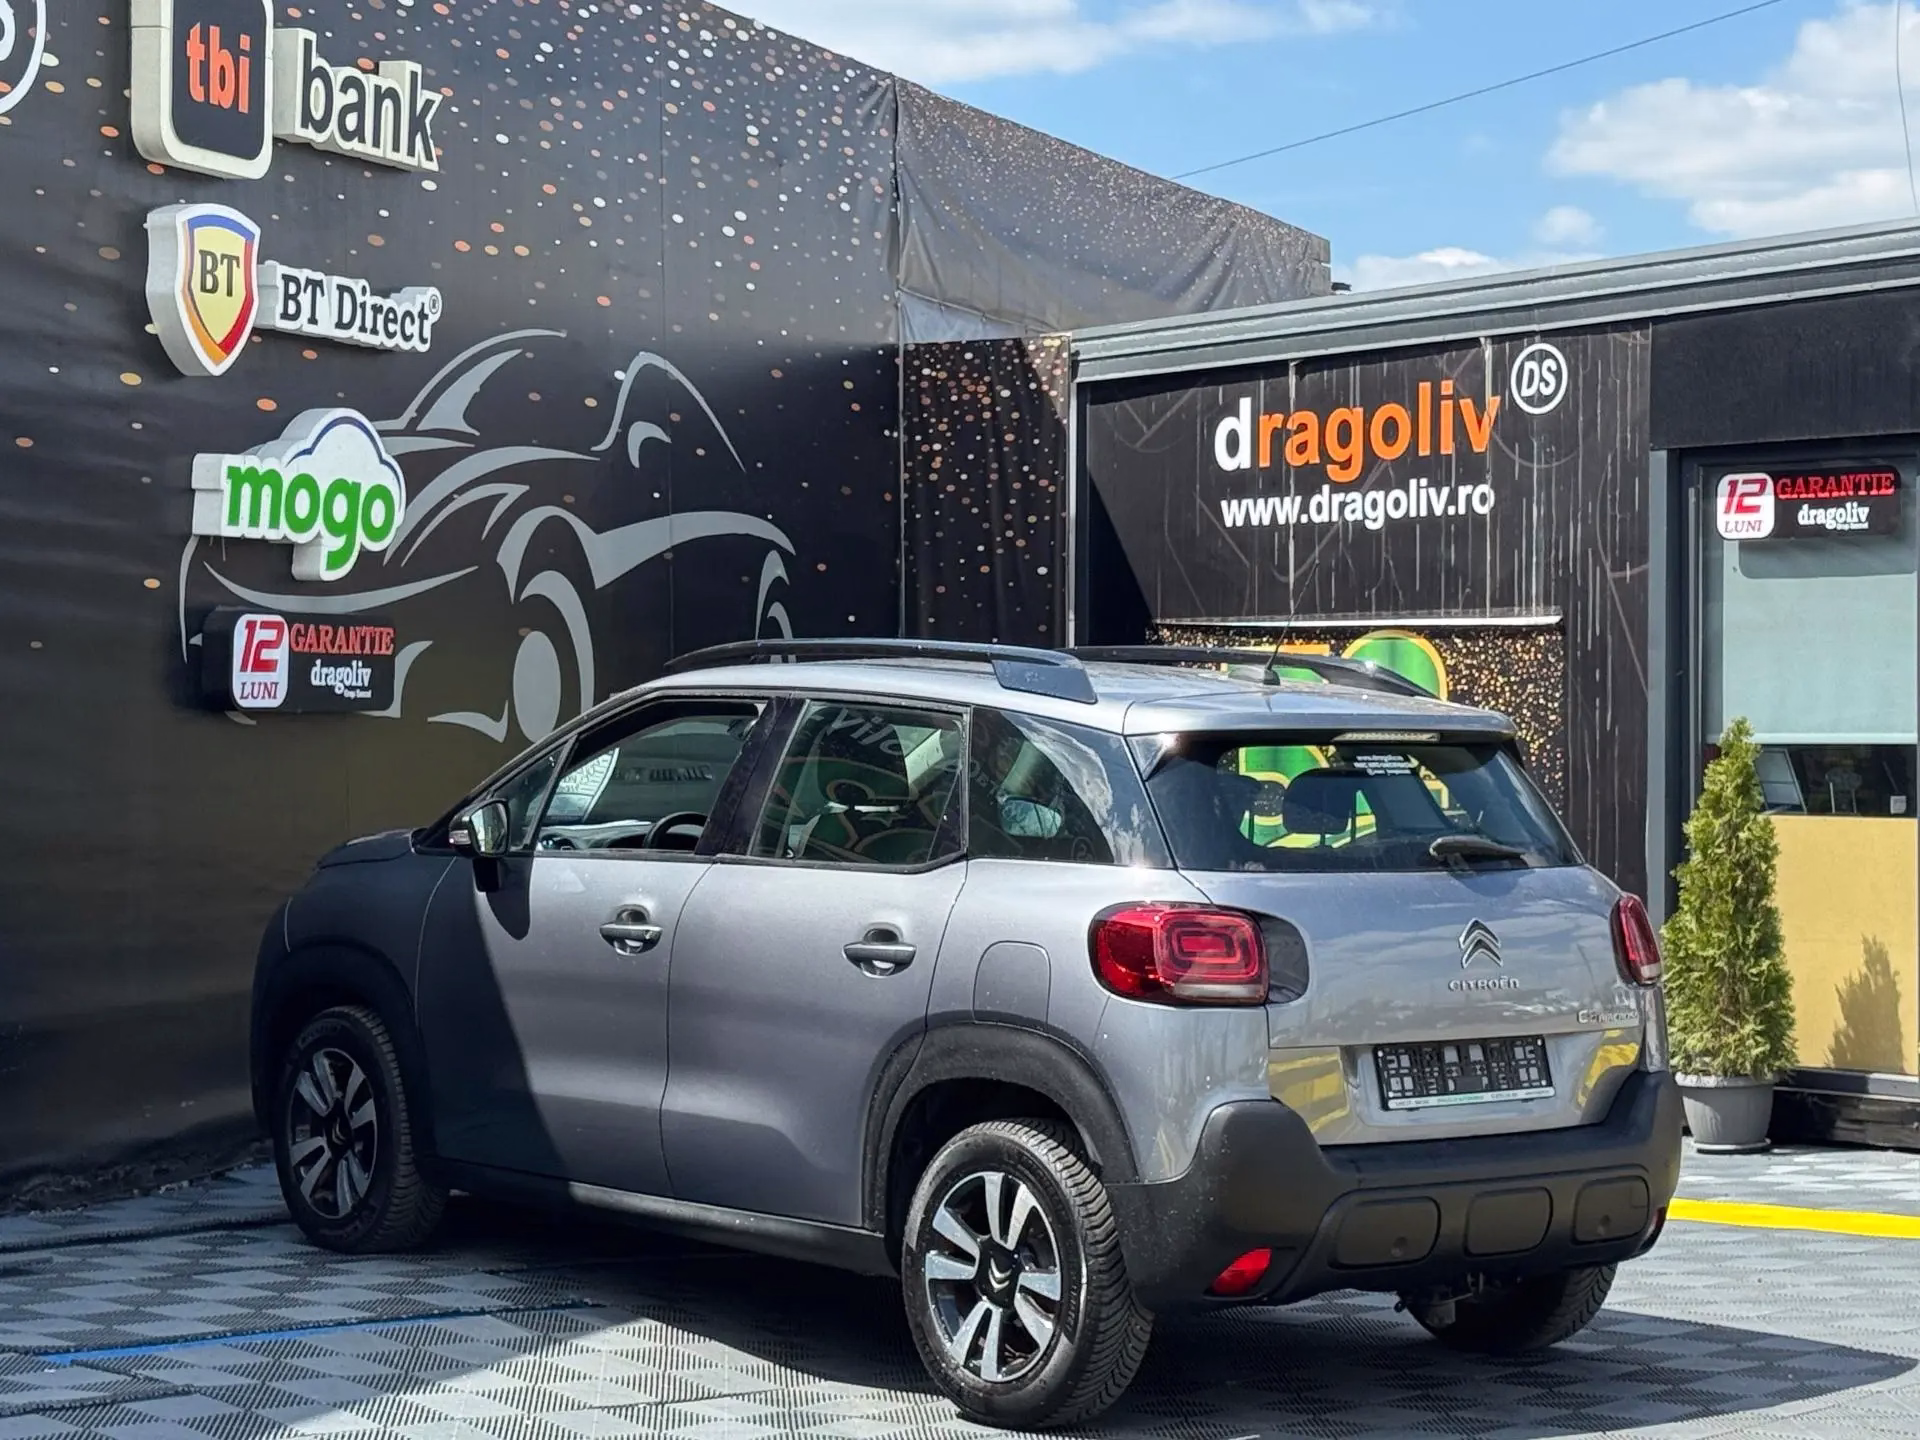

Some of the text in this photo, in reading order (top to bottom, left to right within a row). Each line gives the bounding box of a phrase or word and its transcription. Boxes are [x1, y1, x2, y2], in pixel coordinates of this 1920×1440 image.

[186, 22, 437, 163] tbi bank
[199, 248, 240, 297] BT
[280, 272, 325, 326] BT
[1214, 359, 1558, 484] dragoliv DS
[1220, 478, 1496, 530] www.dragoliv.ro
[1724, 479, 1768, 514] 12
[1777, 474, 1895, 499] GARANTIE
[227, 465, 396, 571] mogo
[1724, 519, 1763, 533] LUNI
[1798, 502, 1870, 529] dragoliv
[239, 620, 285, 673] 12
[290, 623, 395, 656] GARANTIE
[240, 681, 279, 700] LUNI
[310, 658, 372, 694] dragoliv
